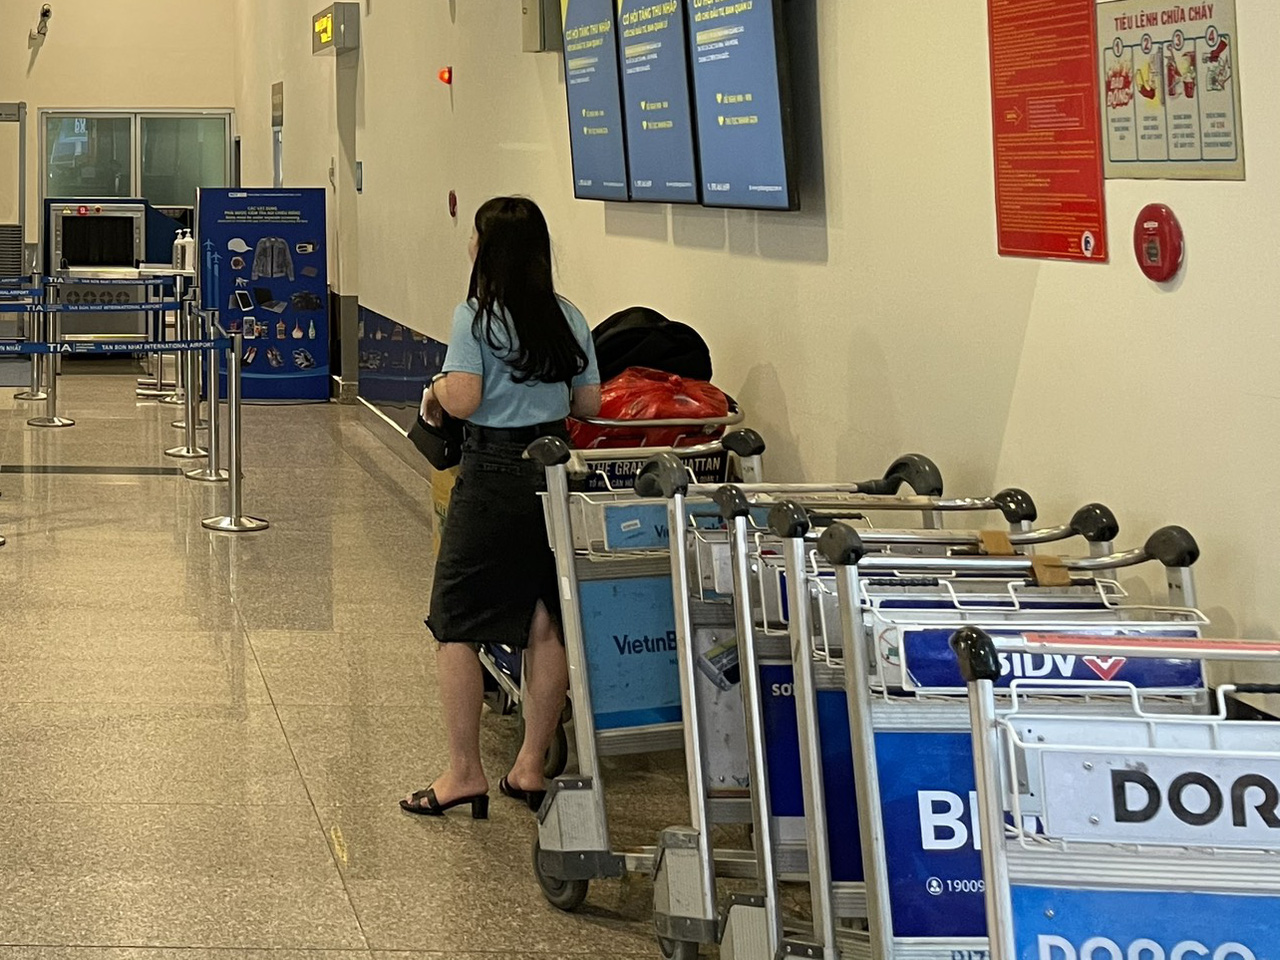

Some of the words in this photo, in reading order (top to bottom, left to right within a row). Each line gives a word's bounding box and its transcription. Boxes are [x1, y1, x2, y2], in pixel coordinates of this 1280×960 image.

[1176, 34, 1182, 47] 3
[1208, 30, 1215, 43] 4
[1144, 38, 1150, 51] 2
[26, 304, 44, 312] TIA
[46, 344, 72, 352] TIA
[1110, 768, 1280, 828] DOR
[946, 879, 986, 893] 19009
